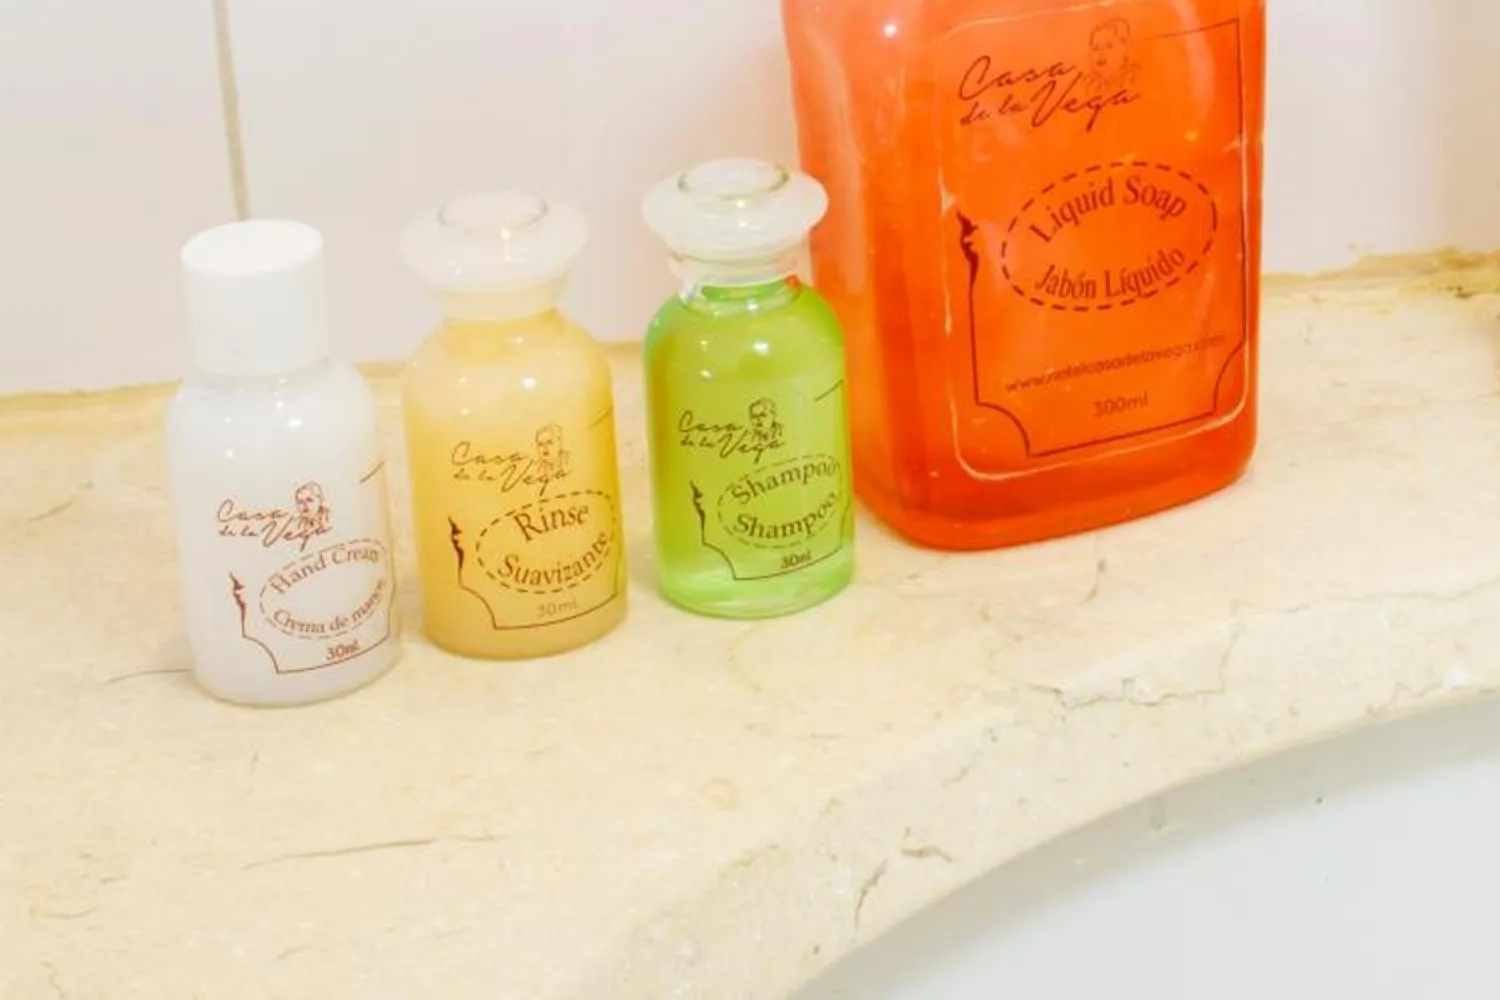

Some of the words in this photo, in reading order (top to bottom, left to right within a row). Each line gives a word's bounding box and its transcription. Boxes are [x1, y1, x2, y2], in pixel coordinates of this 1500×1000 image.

[959, 55, 1078, 101] Casa
[960, 101, 991, 126] de
[1030, 71, 1141, 134] Vega
[1029, 178, 1116, 244] Liquid
[1123, 175, 1189, 221] Soap
[1034, 263, 1098, 301] Jabón
[1104, 245, 1187, 300] Líquido
[678, 410, 745, 433] Casa
[1093, 393, 1150, 419] 300ml
[451, 440, 525, 466] Casa
[718, 430, 785, 465] Vega
[499, 458, 573, 497] Vega
[730, 457, 841, 506] Shampoo
[216, 498, 289, 524] Casa
[513, 503, 590, 543] Rinse
[261, 515, 335, 553] Vega
[269, 553, 328, 595] Hand
[497, 531, 609, 586] Suavizante
[272, 607, 326, 635] Crema
[329, 614, 350, 632] de
